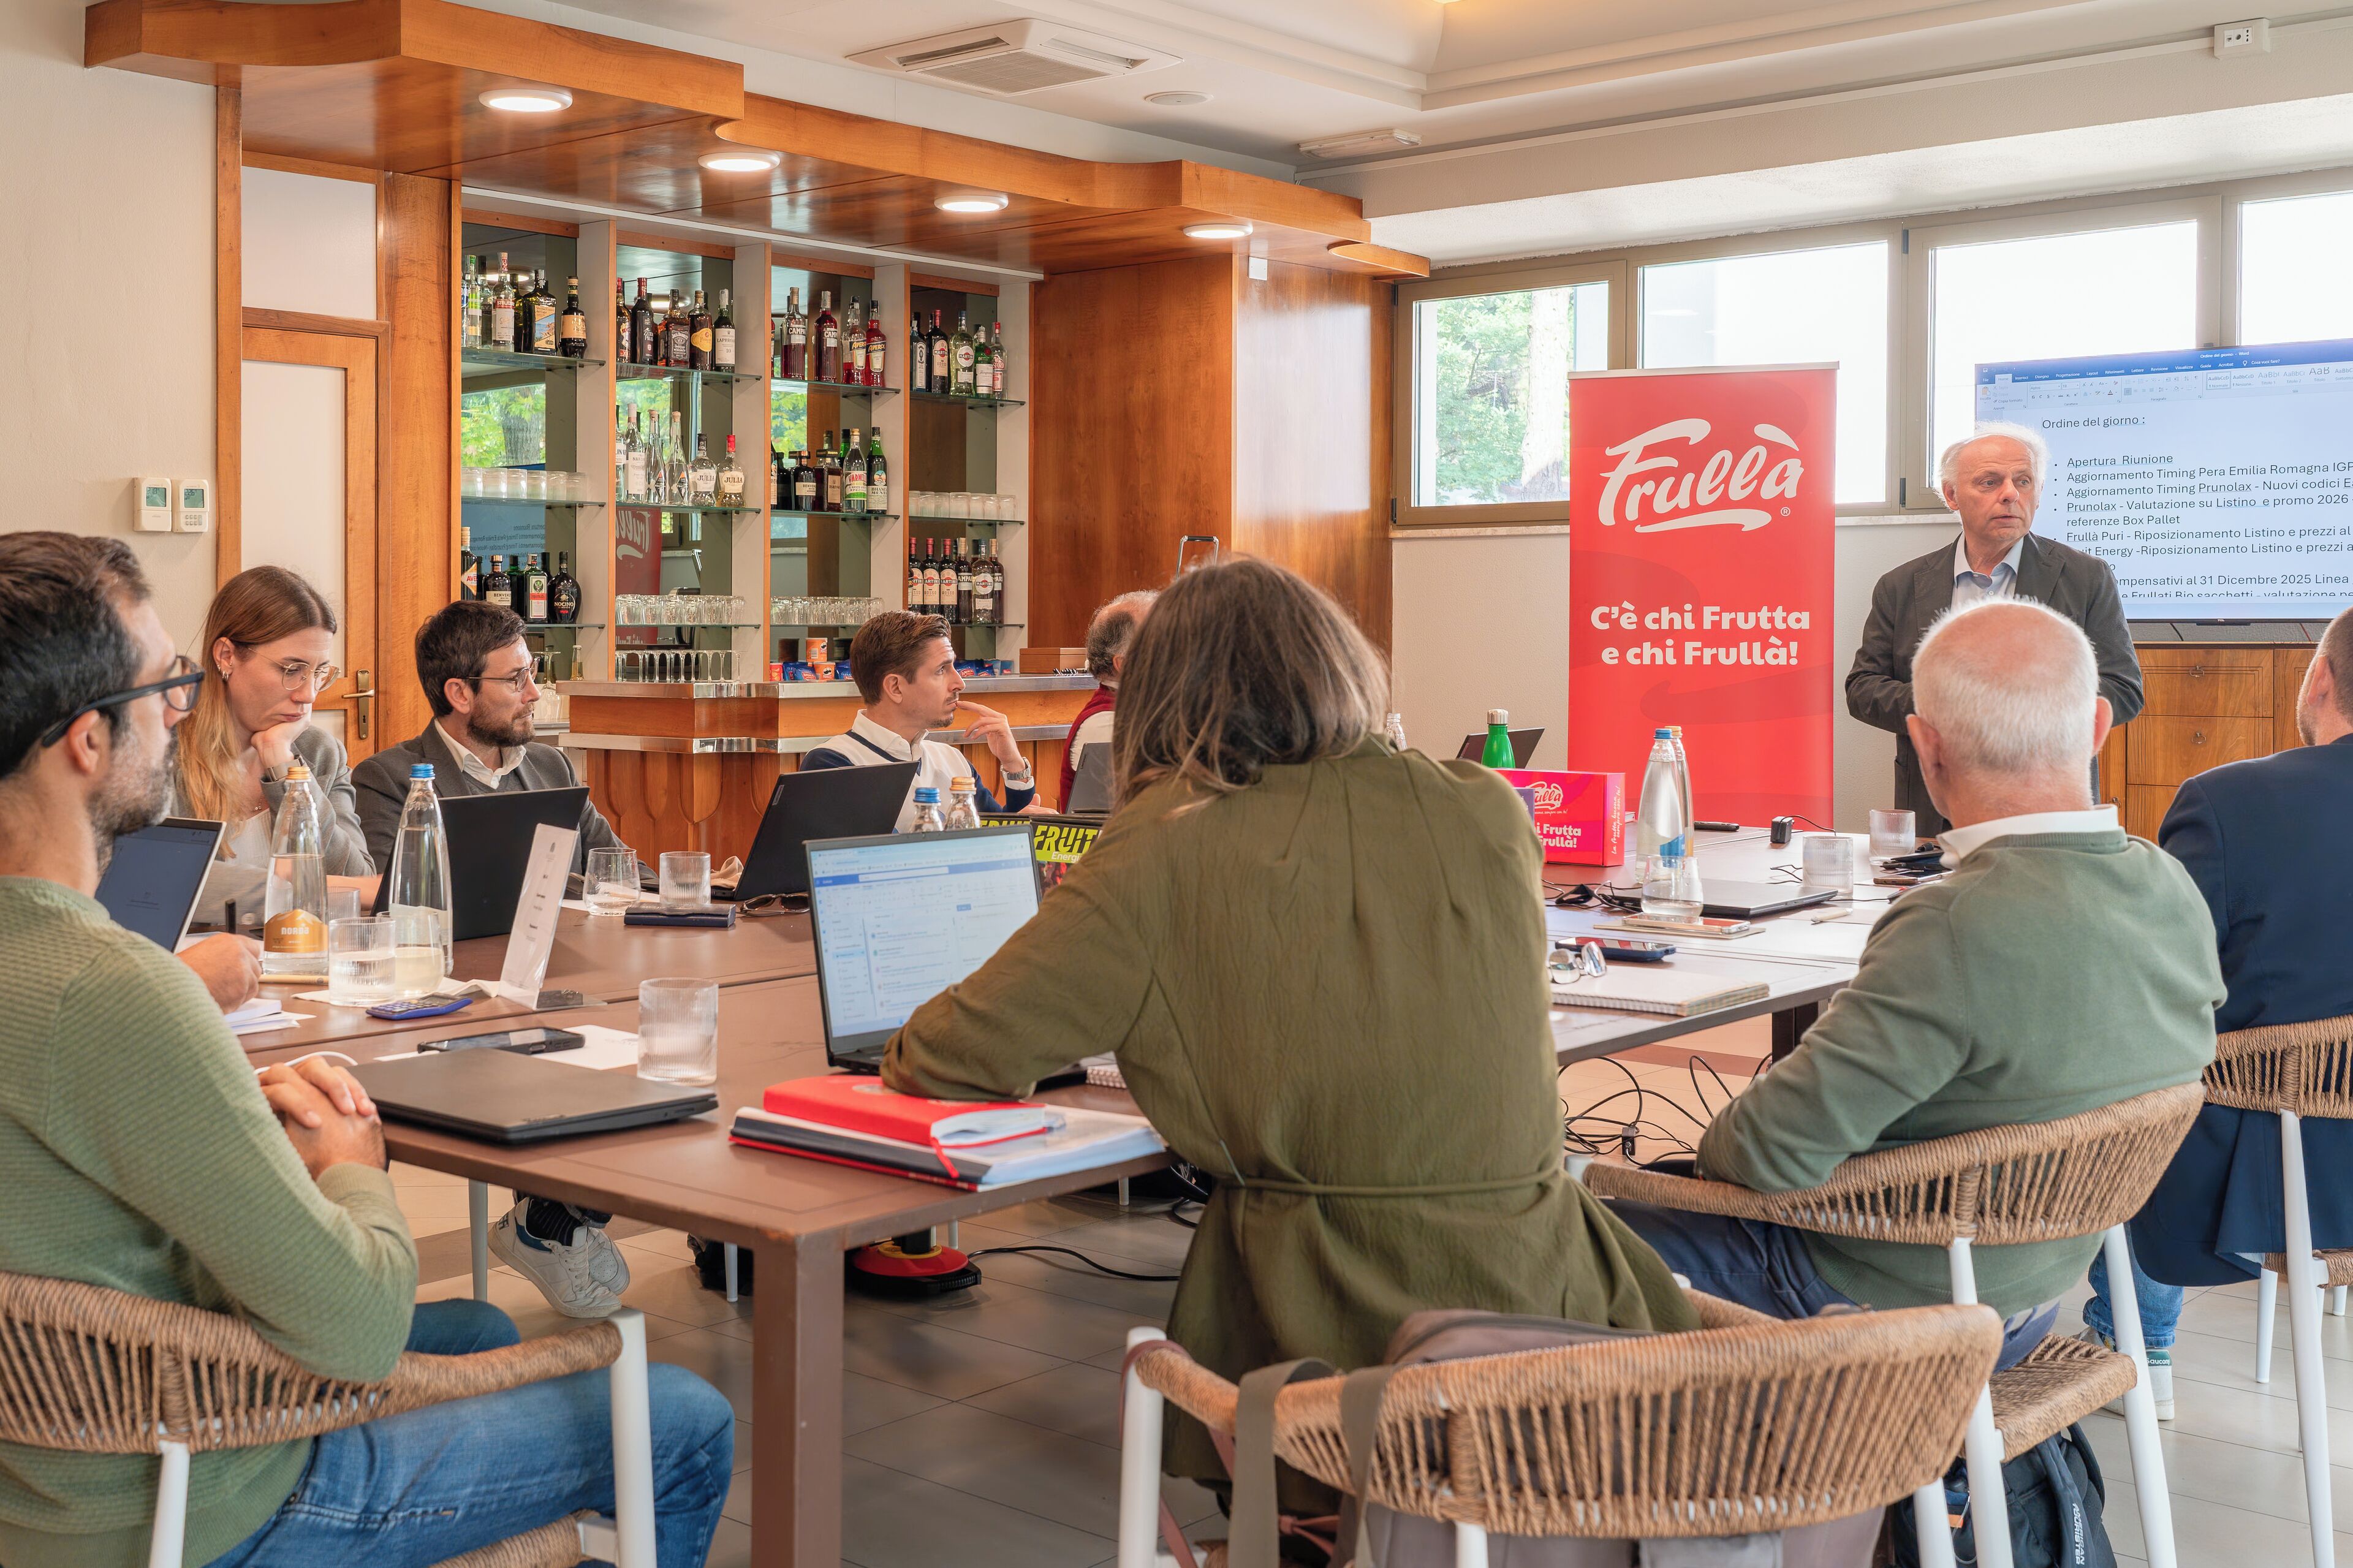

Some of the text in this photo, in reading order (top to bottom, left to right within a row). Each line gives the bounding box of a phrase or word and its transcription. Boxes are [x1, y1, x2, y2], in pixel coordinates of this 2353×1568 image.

[2042, 419, 2080, 429] Ordine
[2083, 417, 2101, 427] del
[2103, 416, 2139, 428] giorno
[2067, 454, 2173, 469] Apertura Riunione
[1598, 418, 1805, 526] Frullà
[2067, 472, 2154, 484] Aggiornamento
[2157, 468, 2196, 480] Timing
[2199, 467, 2226, 477] Pera
[2229, 465, 2267, 476] Emilia
[2270, 464, 2329, 475] Romagna
[2067, 487, 2154, 499] Aggiornamento
[2156, 484, 2196, 495] Timing
[2199, 482, 2252, 493] Prunolax
[2263, 479, 2298, 491] Nuovi
[2302, 478, 2340, 489] codici
[2344, 478, 2353, 488] E
[2067, 502, 2117, 512] Prunolax
[2126, 499, 2196, 510] Valutazione
[2216, 496, 2256, 508] Listino
[2273, 498, 2314, 508] promo
[2317, 494, 2349, 504] 2026
[2067, 515, 2180, 527] referenze Box Pallet
[2067, 531, 2098, 542] Frullà
[2102, 531, 2124, 541] Puri
[2134, 529, 2241, 540] Riposizionamento
[2245, 527, 2285, 538] Listino
[2299, 527, 2336, 539] prezzi
[2340, 526, 2351, 536] al
[2095, 546, 2134, 558] Energy
[2135, 543, 2248, 557] -Riposizionamento
[2251, 543, 2292, 553] Listino
[2306, 542, 2343, 554] prezzi
[2186, 575, 2196, 585] al
[2200, 575, 2213, 585] 31
[2218, 574, 2278, 585] Dicembre
[2281, 574, 2311, 584] 2025
[2315, 574, 2349, 584] Linea
[1591, 600, 1810, 630] C'è chi Frutta
[1601, 635, 1799, 665] e chi Frullà!
[1543, 824, 1582, 836] Frutta
[1034, 825, 1098, 854] FRUIT
[1611, 846, 1617, 854] La
[2072, 1502, 2085, 1565] AMERICAN
